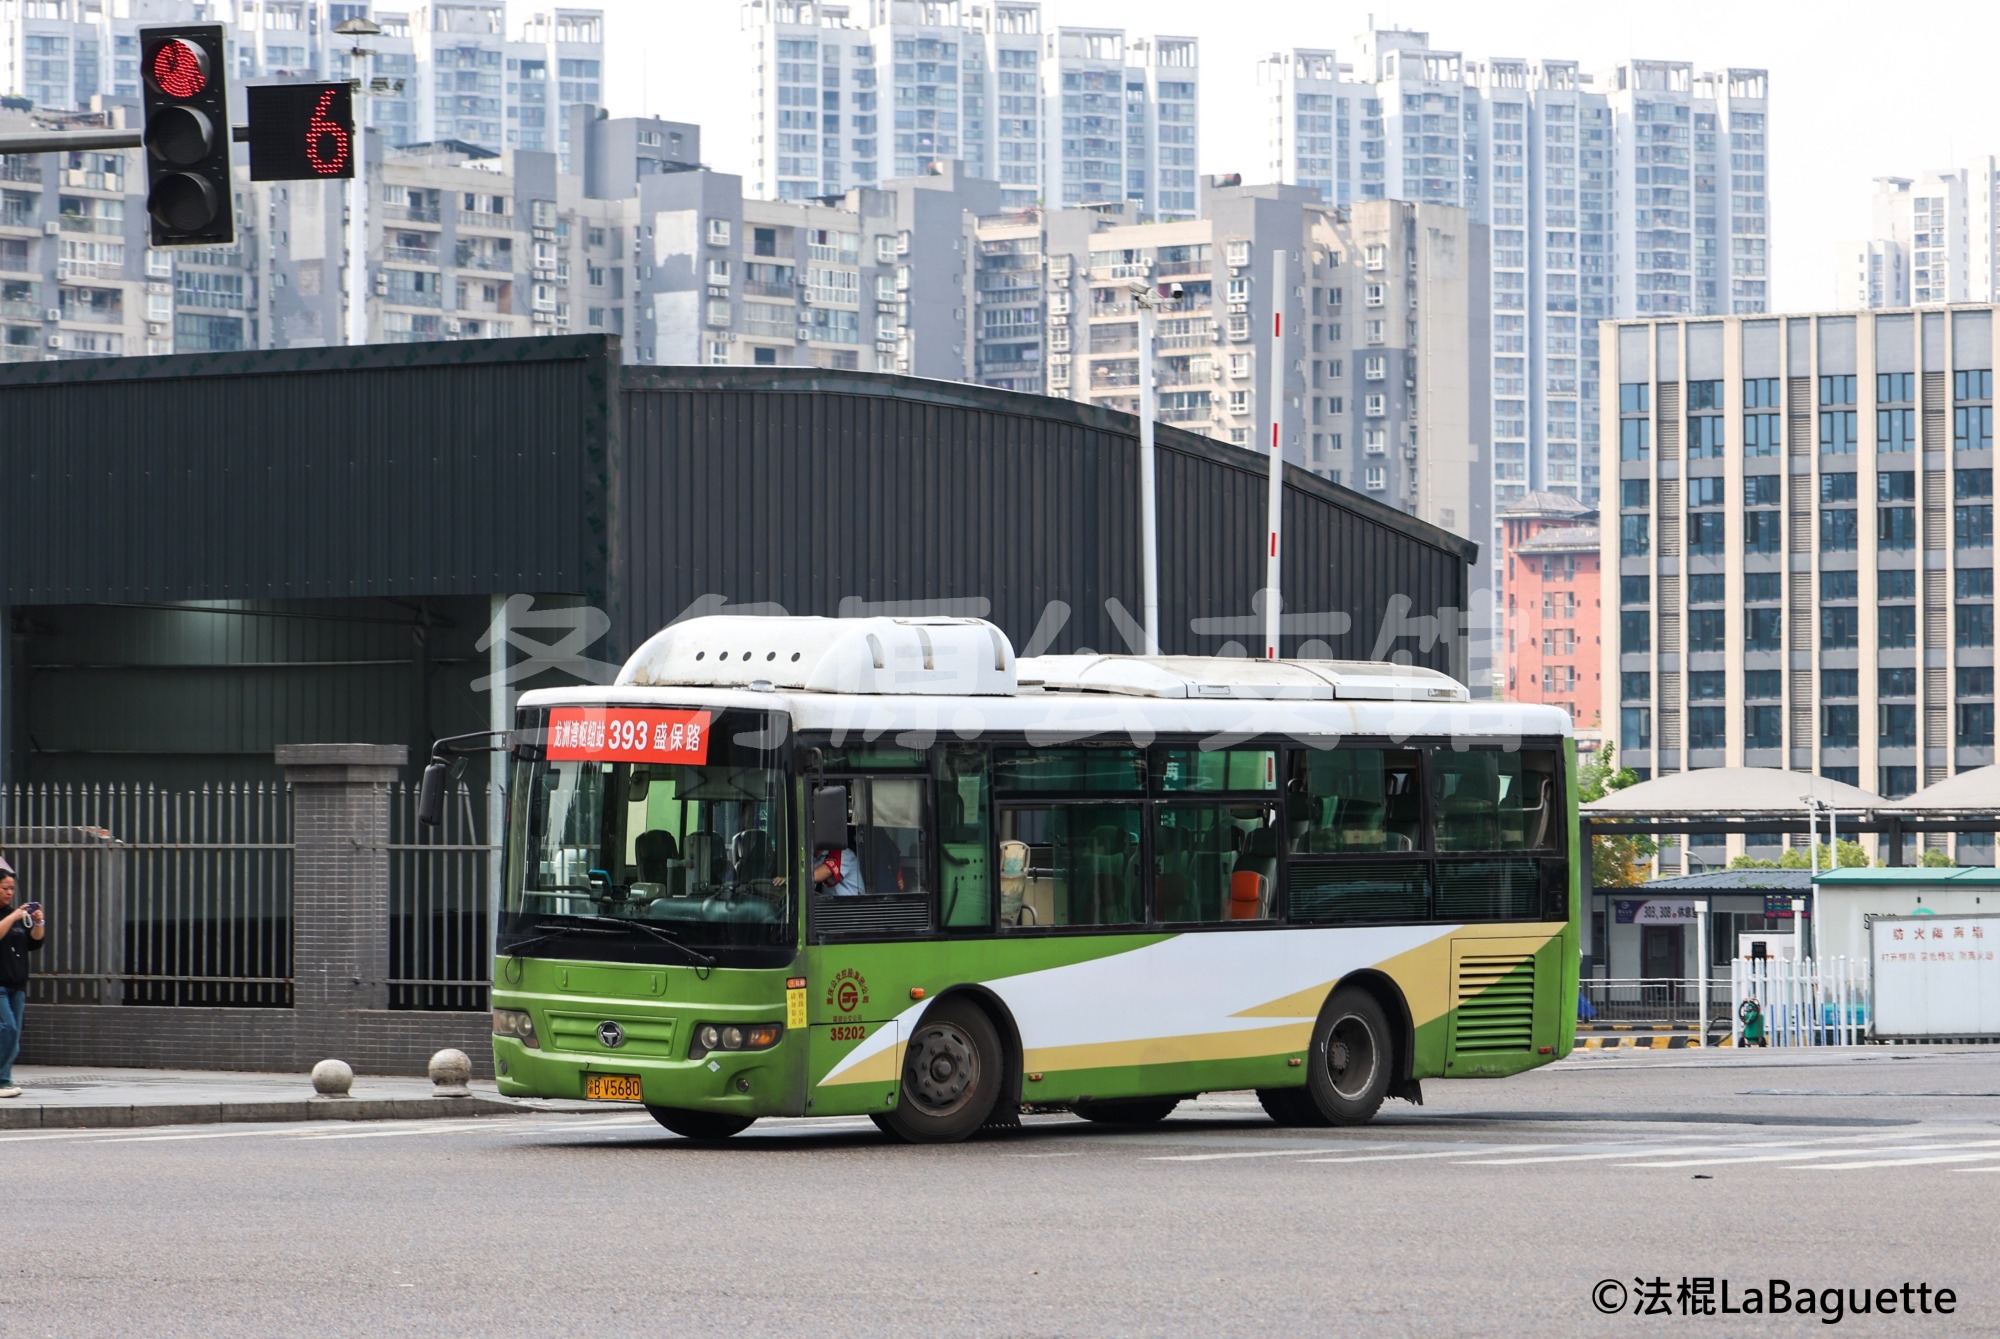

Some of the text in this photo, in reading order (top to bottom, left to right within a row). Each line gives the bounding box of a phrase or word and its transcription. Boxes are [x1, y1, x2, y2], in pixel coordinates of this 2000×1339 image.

[305, 89, 348, 174] 6
[553, 719, 700, 751] 龙洲湾枢纽站 393 盛保路
[830, 1026, 865, 1041] 35202
